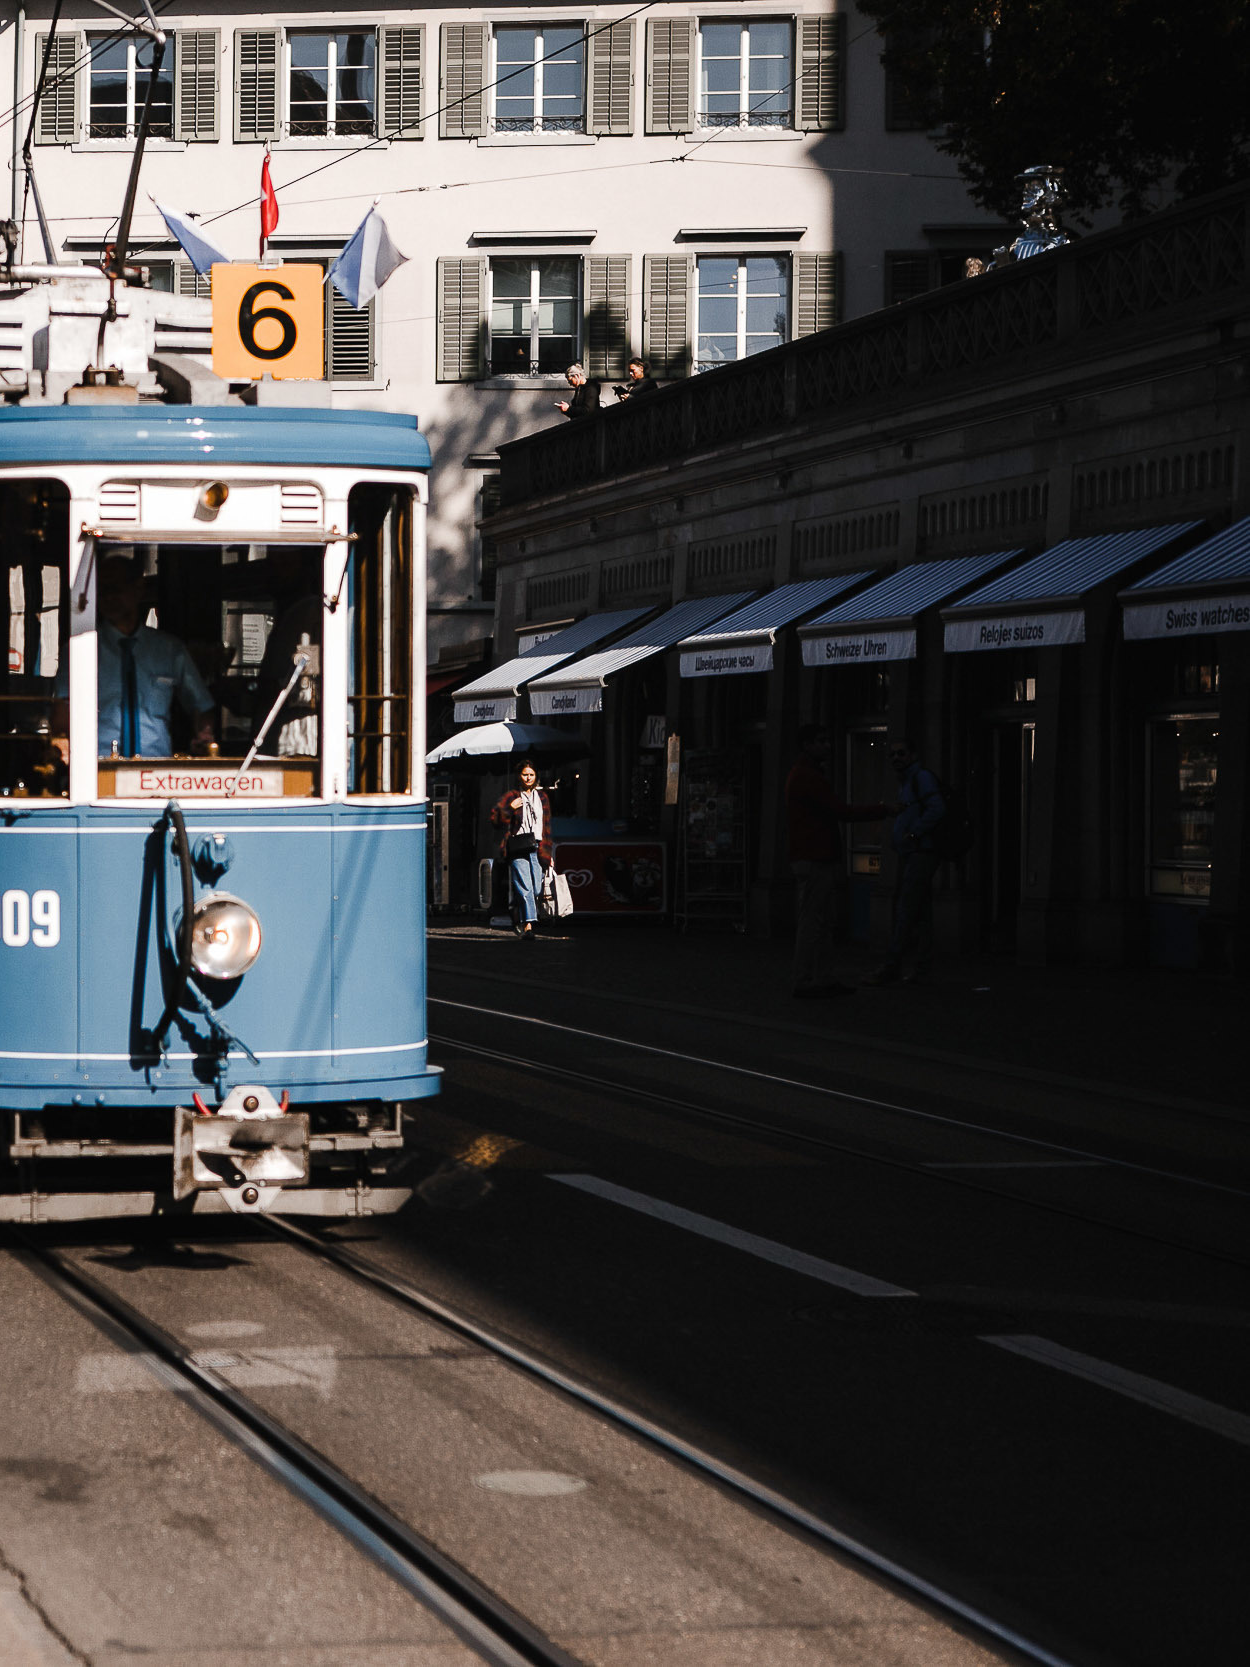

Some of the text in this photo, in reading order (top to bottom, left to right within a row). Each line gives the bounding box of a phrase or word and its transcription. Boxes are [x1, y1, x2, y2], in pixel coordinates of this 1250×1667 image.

[238, 281, 298, 361] 6
[1165, 603, 1250, 630] Swiss watches
[979, 622, 1044, 646] Relojes suizos
[825, 639, 887, 659] Schweizer Uhren
[738, 655, 755, 668] часы
[472, 703, 496, 719] Candyland
[551, 695, 577, 711] Candyland
[140, 770, 263, 796] Extrawagen
